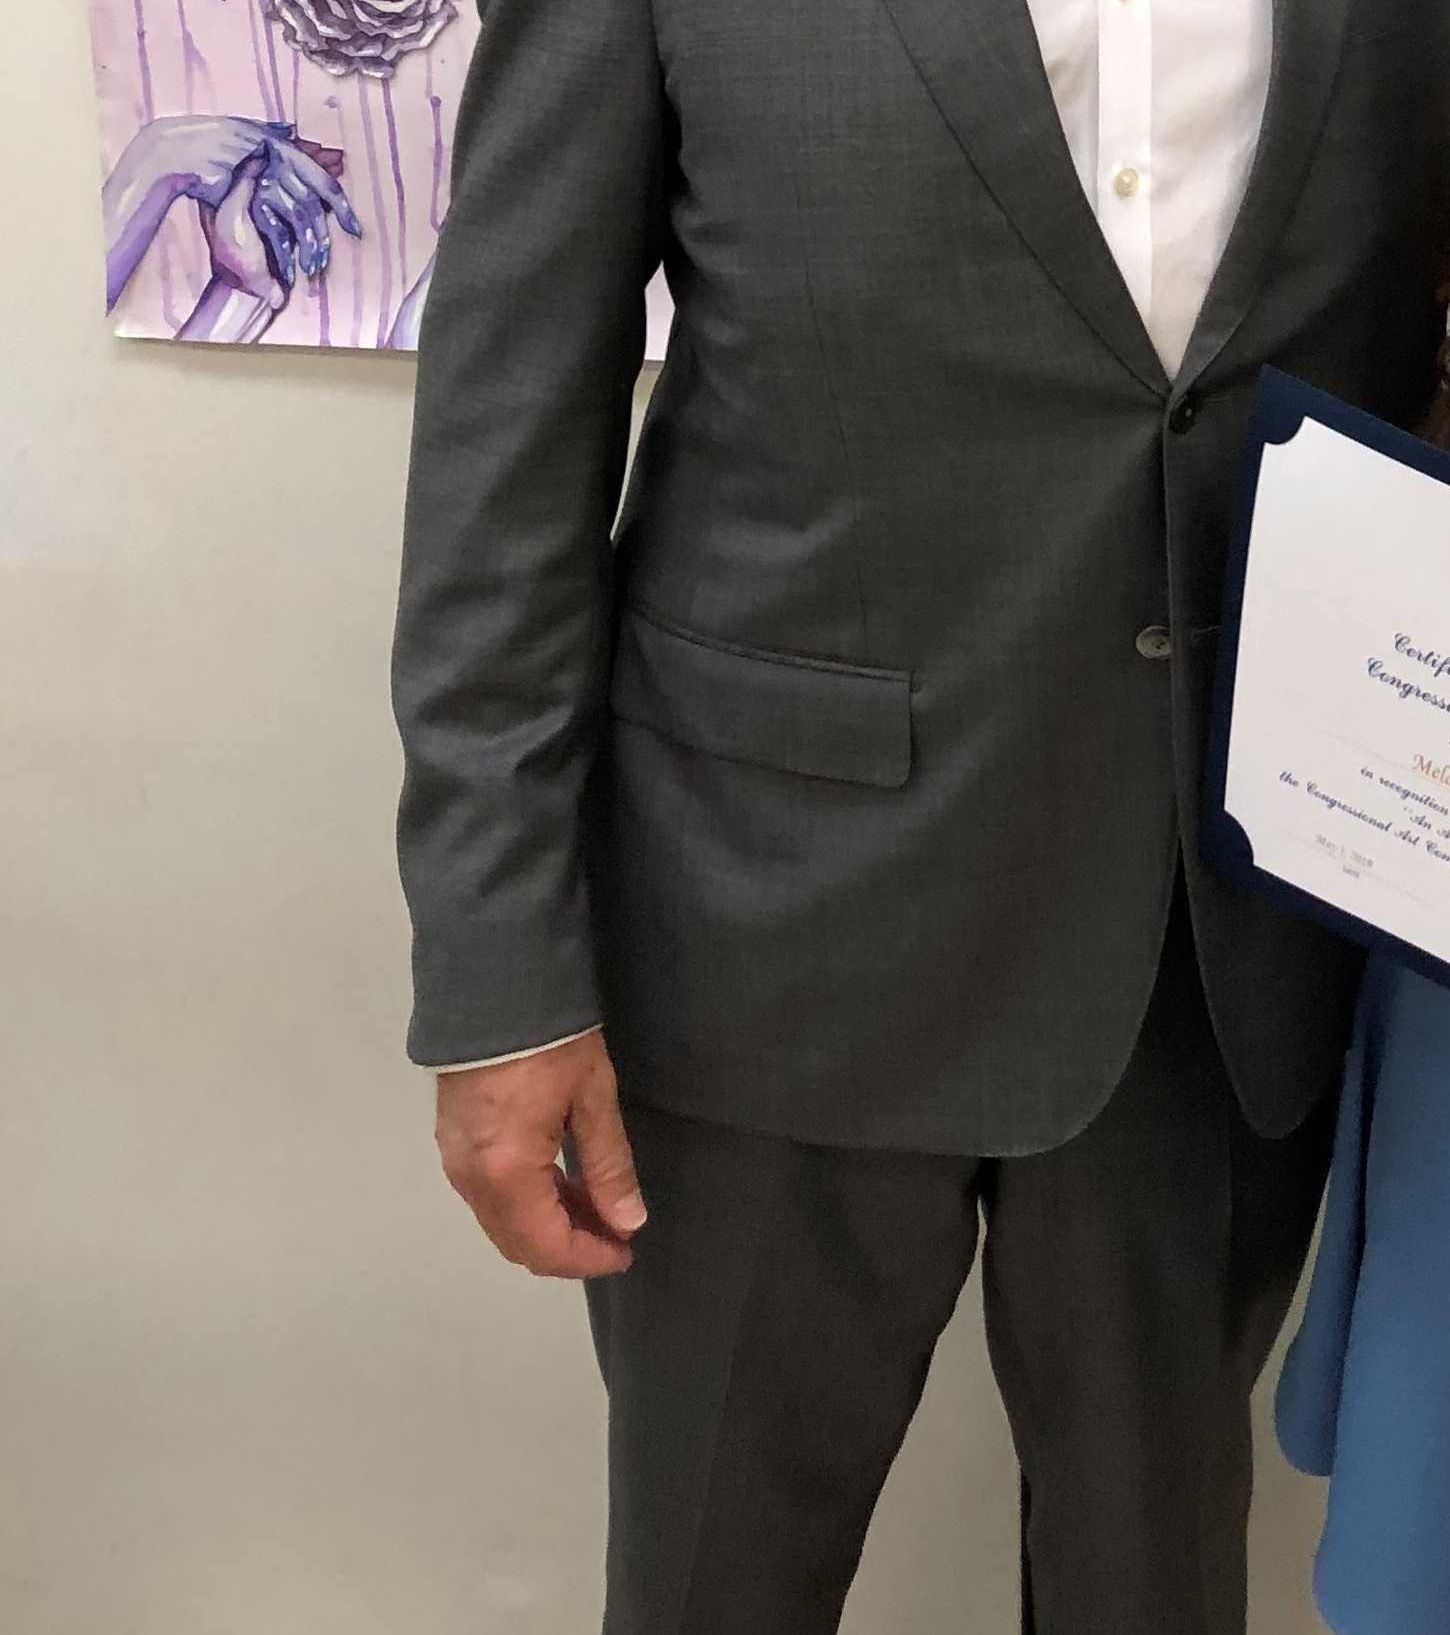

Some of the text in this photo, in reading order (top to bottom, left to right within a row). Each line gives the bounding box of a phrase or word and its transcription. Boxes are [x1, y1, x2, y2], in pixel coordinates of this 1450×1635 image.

[1279, 770, 1300, 787] the
[1306, 781, 1393, 832] Congressional
[1394, 830, 1420, 846] Art
[1360, 766, 1374, 779] in
[1379, 776, 1449, 816] recognition
